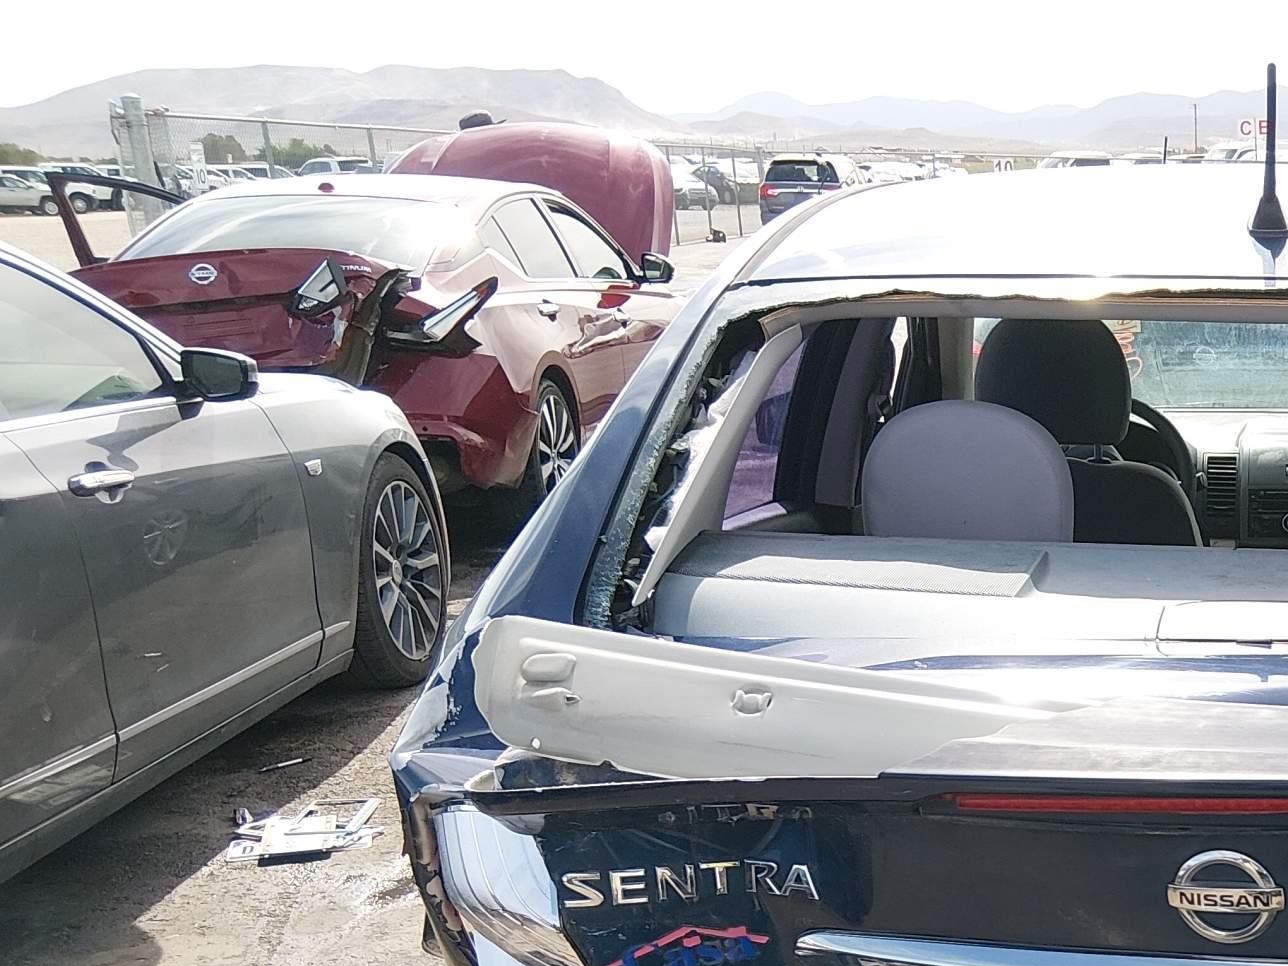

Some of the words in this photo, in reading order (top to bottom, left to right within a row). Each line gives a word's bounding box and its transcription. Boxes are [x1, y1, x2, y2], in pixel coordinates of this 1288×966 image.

[1240, 121, 1251, 135] C
[194, 168, 206, 184] 10
[561, 858, 820, 908] SENTRA
[1179, 891, 1271, 908] NISSAN
